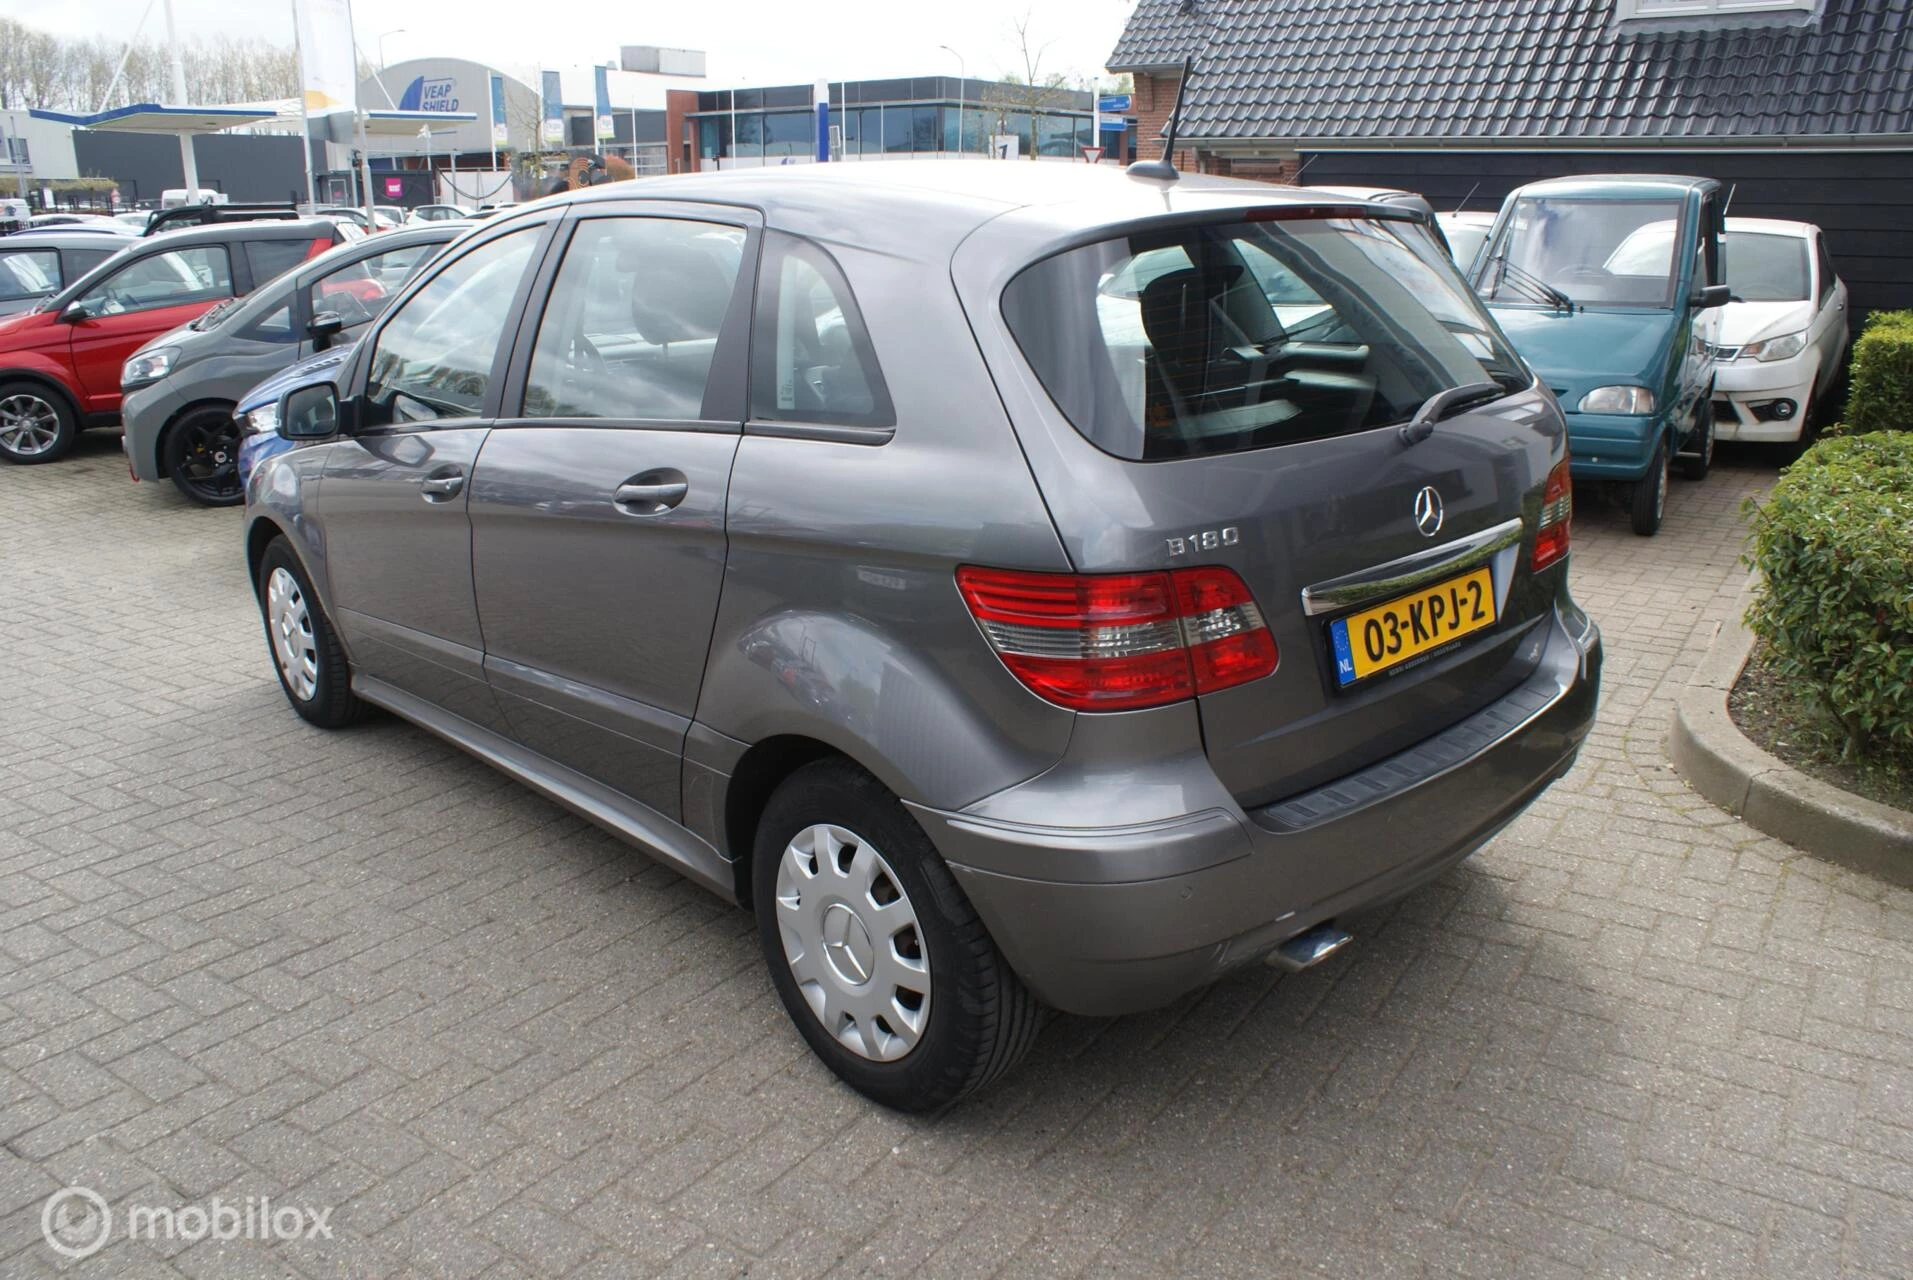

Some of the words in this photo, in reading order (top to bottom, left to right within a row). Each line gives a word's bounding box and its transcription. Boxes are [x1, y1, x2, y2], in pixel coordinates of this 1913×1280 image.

[423, 84, 452, 99] VEAP
[422, 99, 459, 112] SHIELD
[1166, 527, 1240, 557] B180
[1364, 580, 1486, 662] 03-KPJ-2
[1338, 660, 1353, 674] NL
